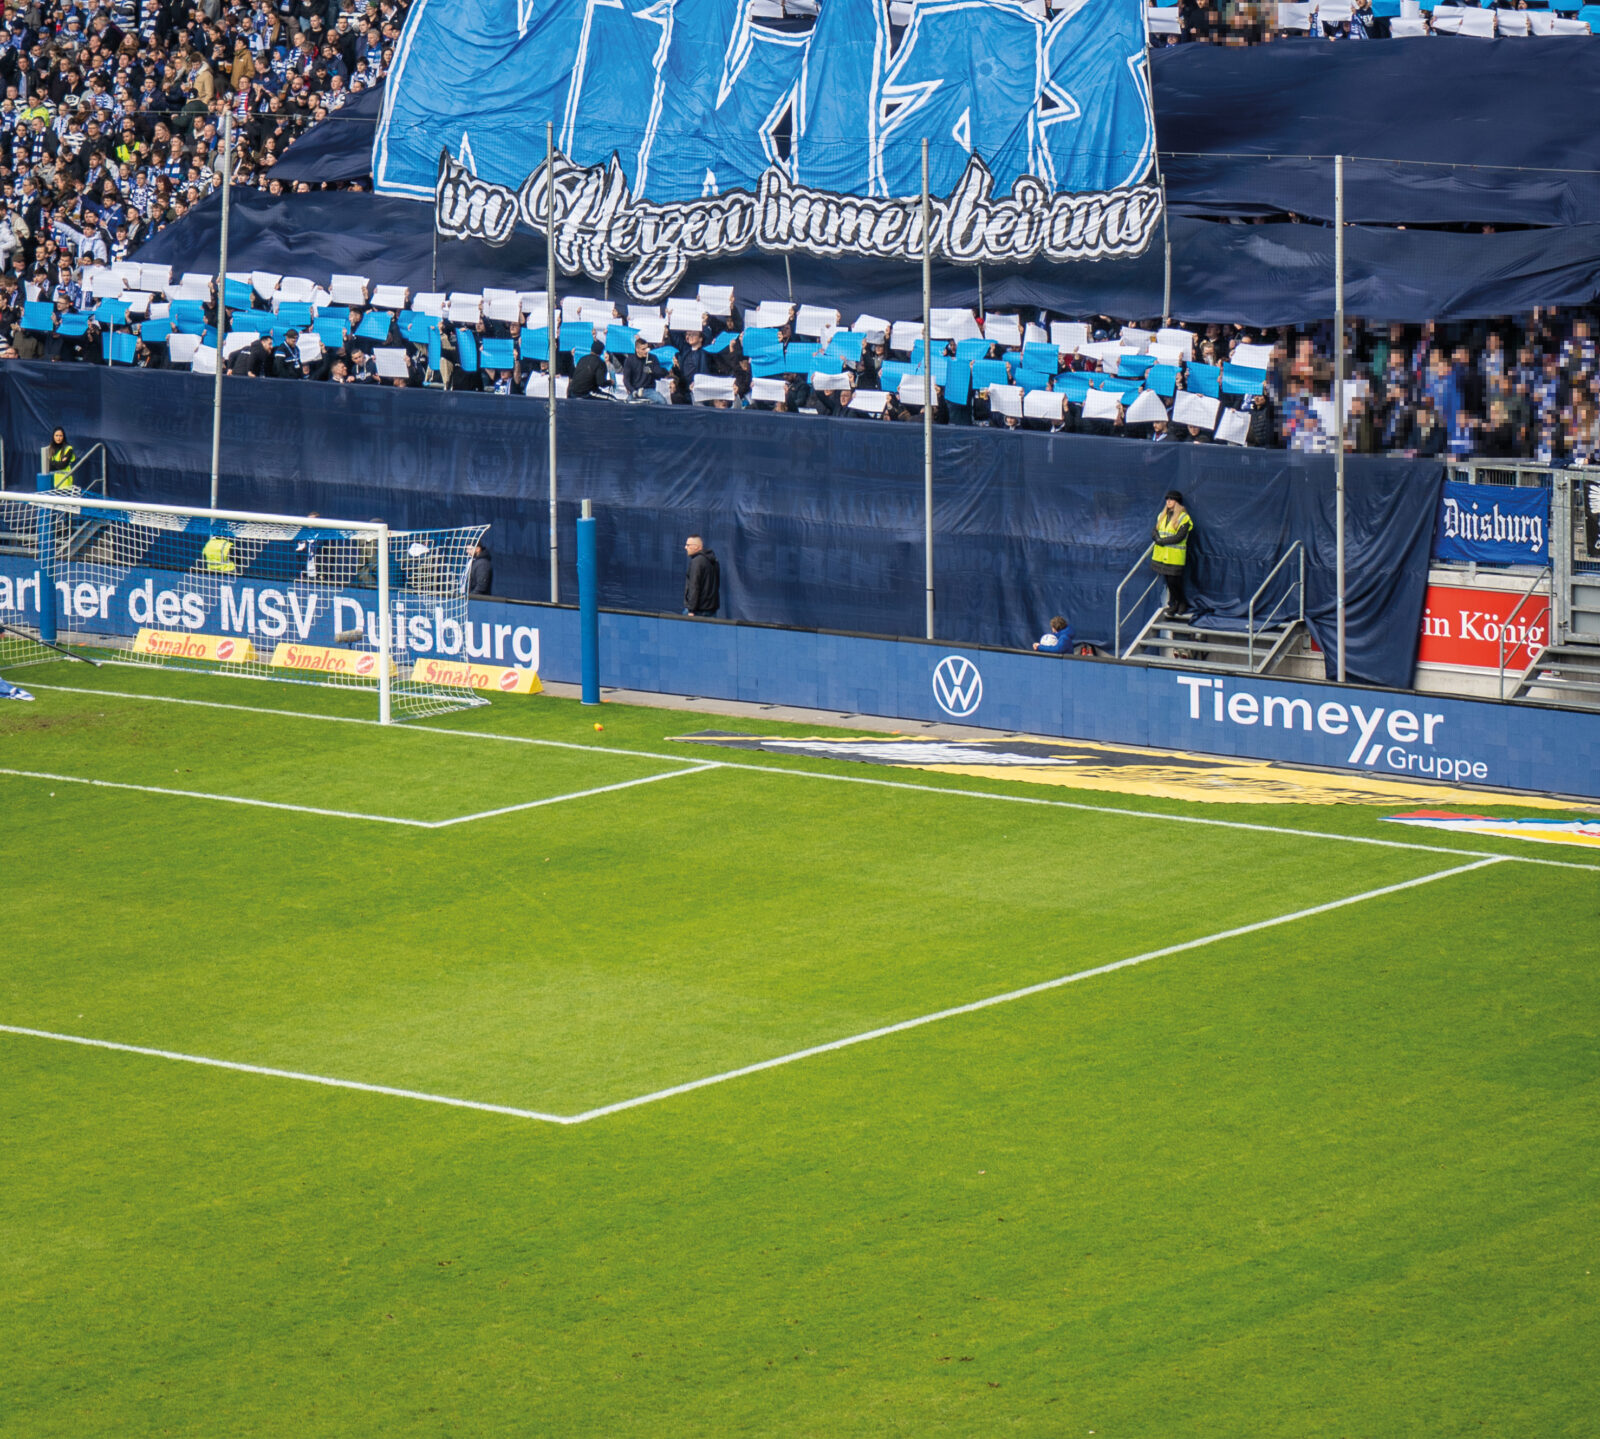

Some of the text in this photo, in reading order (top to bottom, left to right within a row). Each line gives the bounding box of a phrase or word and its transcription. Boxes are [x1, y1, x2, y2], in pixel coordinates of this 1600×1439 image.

[436, 146, 1163, 306] im Herzen immer bei uns
[1443, 498, 1543, 553] Duisburg
[0, 570, 540, 674] artner des MSV Duisburg
[145, 631, 207, 659] Sinalco
[1422, 608, 1545, 658] in König
[283, 646, 346, 672] Sinalco
[423, 661, 489, 689] Sinalco
[1176, 675, 1444, 765] Tiemeyer
[1386, 745, 1488, 782] Gruppe
